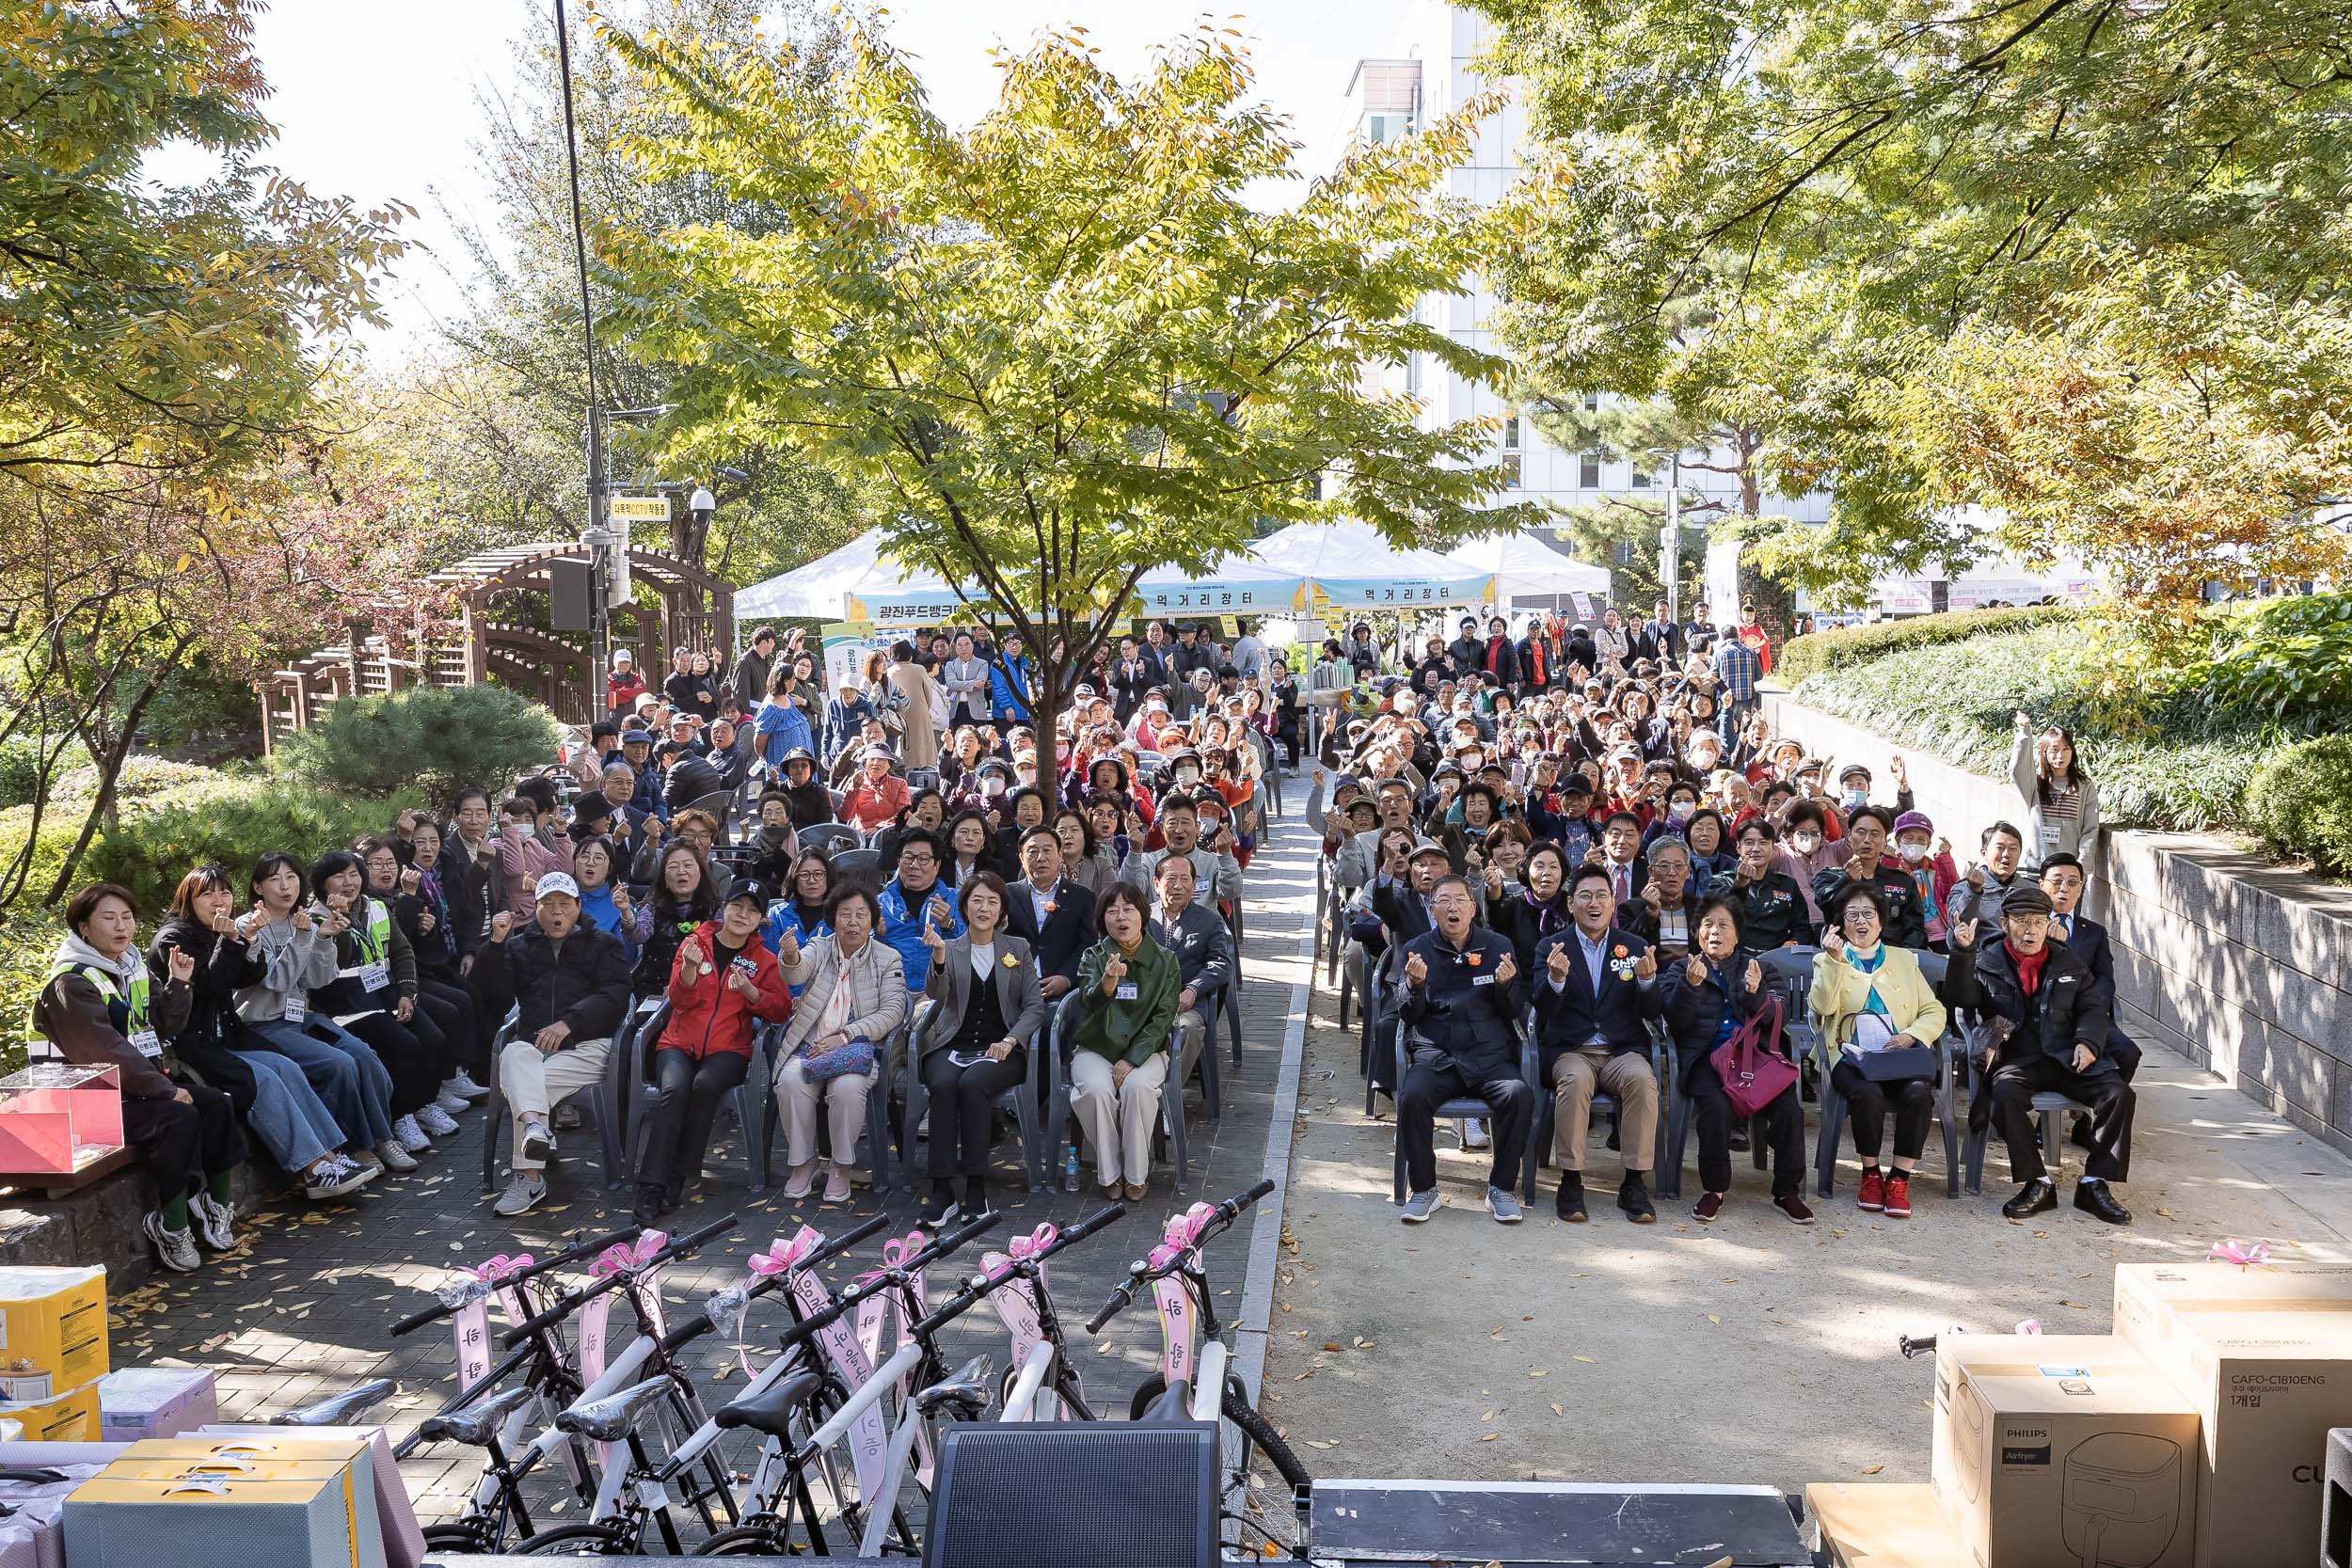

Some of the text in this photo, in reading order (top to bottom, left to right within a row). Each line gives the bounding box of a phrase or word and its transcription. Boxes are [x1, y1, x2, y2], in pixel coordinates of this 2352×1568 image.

[1156, 592, 1252, 607] 먹거리장터
[1365, 586, 1449, 601] 먹거리장터
[2231, 1374, 2327, 1386] CAFO-C1810ENG
[2230, 1395, 2261, 1408] 1개입
[2007, 1429, 2047, 1438] PHILIPS
[2006, 1451, 2037, 1461] Airfryer
